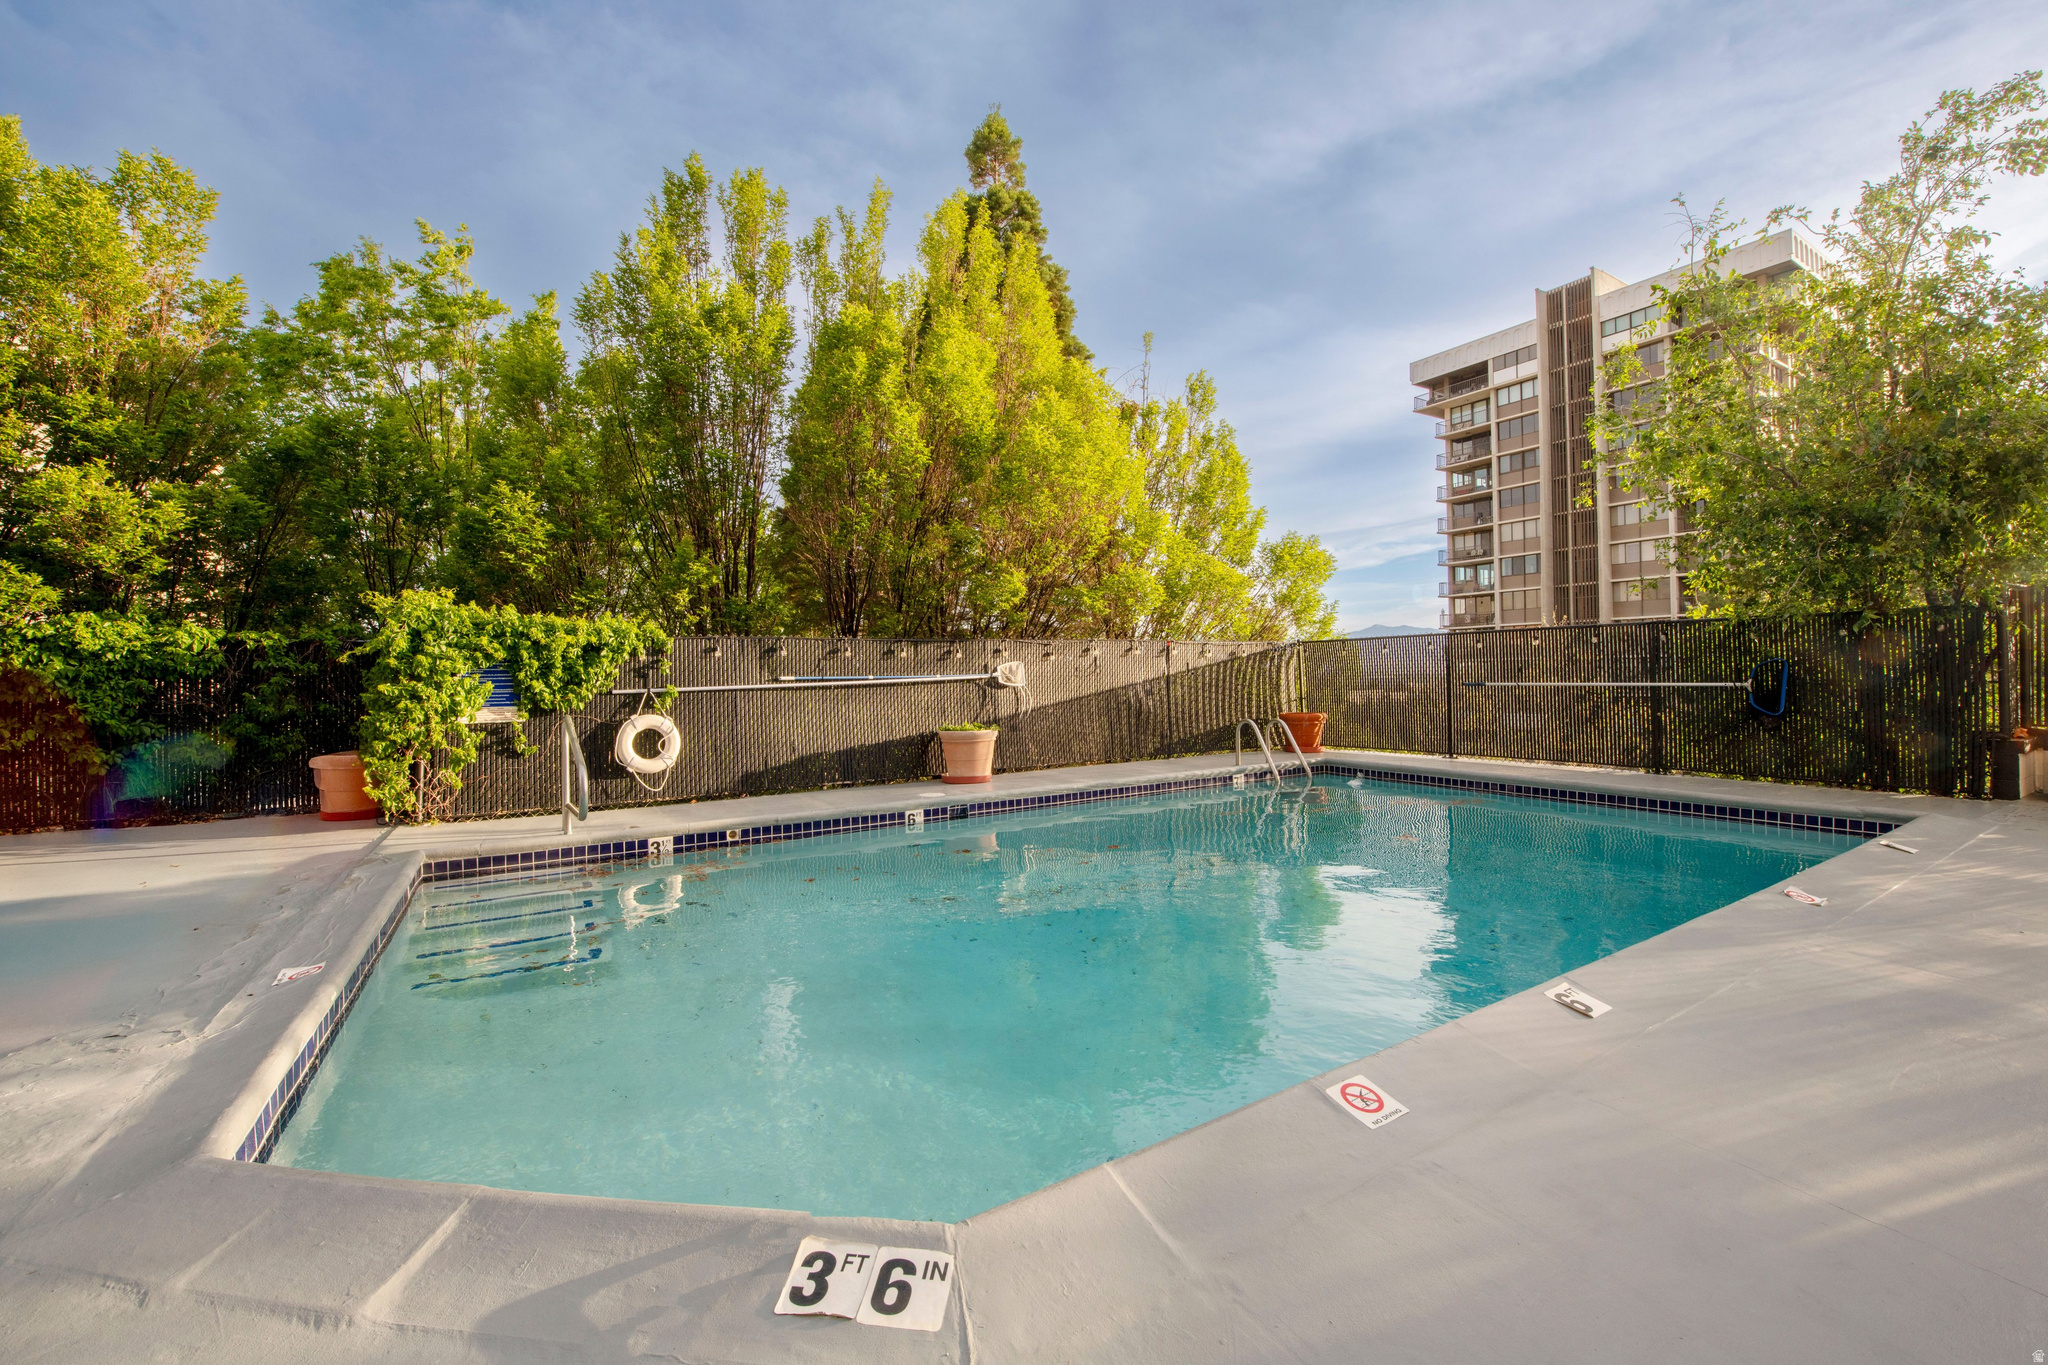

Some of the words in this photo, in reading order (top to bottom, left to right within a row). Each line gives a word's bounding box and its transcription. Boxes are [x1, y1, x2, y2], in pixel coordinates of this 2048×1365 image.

[907, 813, 916, 826] 6
[650, 841, 661, 855] 3
[1554, 992, 1594, 1013] 6
[1371, 1118, 1383, 1126] NO
[1381, 1107, 1402, 1121] DIVING
[789, 1250, 837, 1307] 3
[841, 1253, 871, 1274] FT
[870, 1258, 917, 1316] 6
[921, 1260, 949, 1282] IN
